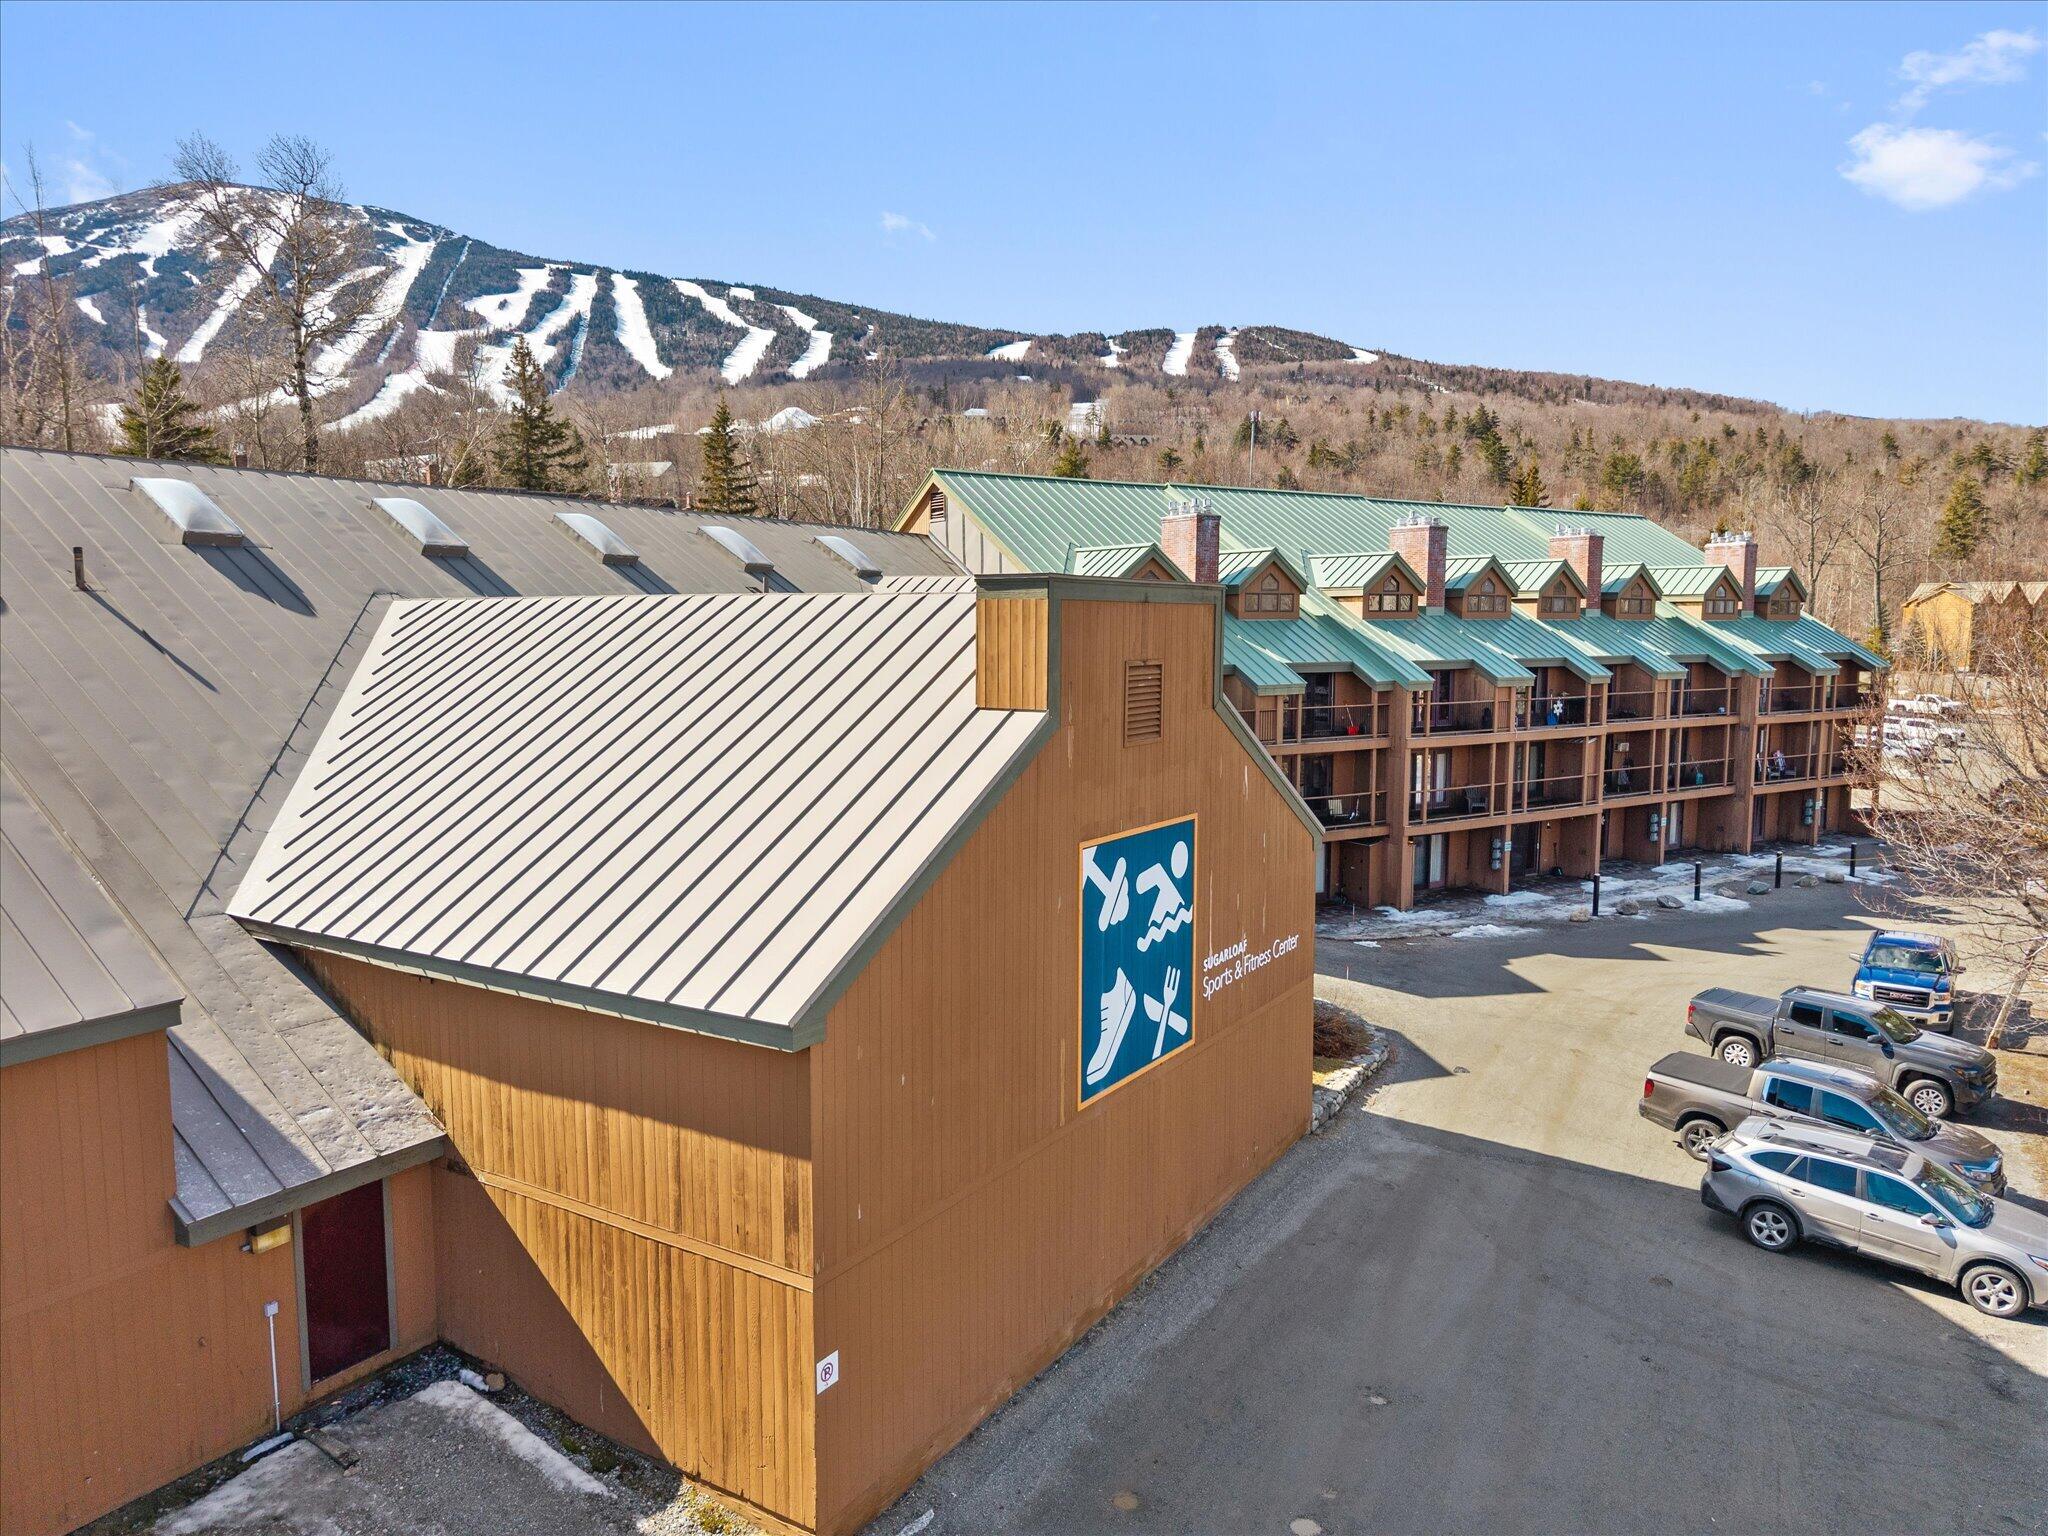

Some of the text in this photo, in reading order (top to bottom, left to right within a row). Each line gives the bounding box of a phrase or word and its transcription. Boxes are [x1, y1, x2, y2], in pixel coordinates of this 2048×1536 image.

[1203, 939, 1247, 972] SUGARLOAF
[1203, 935, 1299, 1000] Sports & Fitness Center
